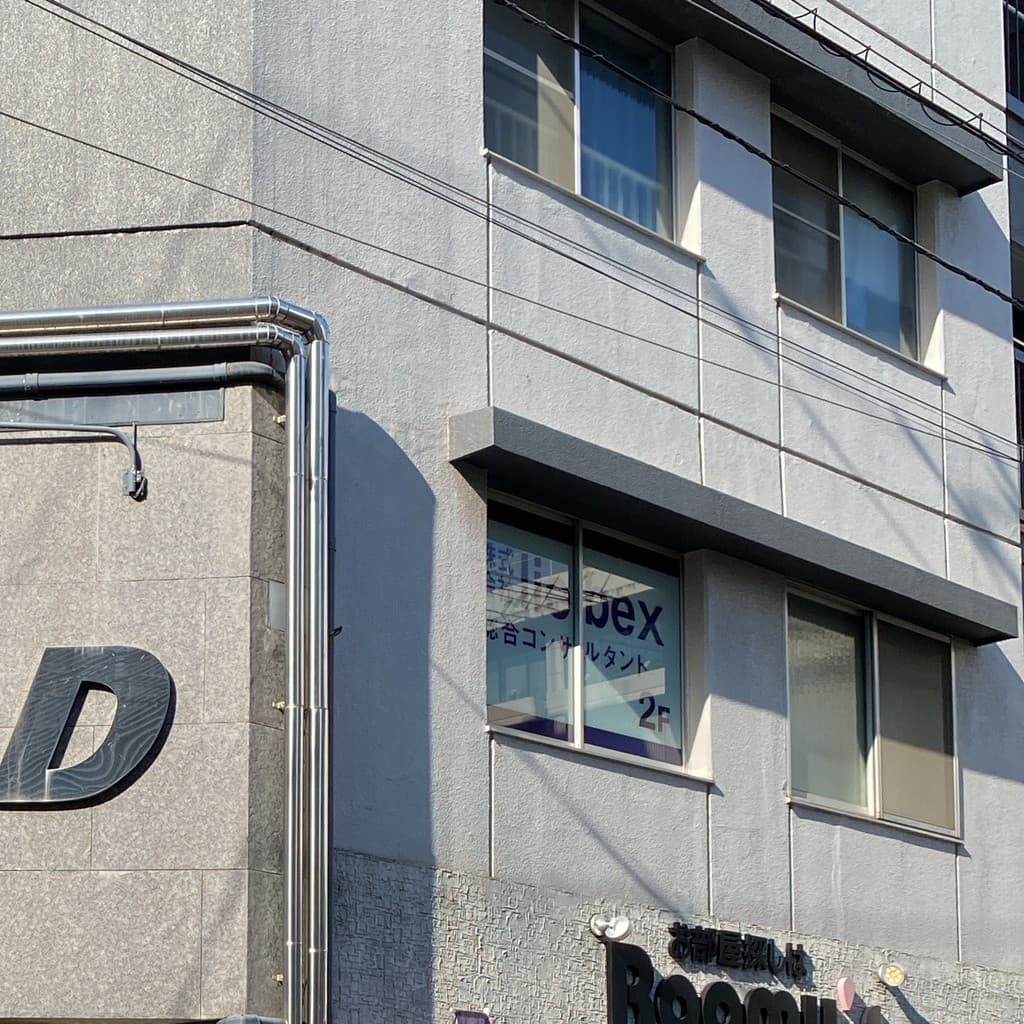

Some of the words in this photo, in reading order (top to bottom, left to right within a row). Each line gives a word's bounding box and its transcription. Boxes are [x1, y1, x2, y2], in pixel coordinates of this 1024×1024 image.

[639, 696, 670, 733] 2F
[667, 921, 808, 979] お部屋探しは
